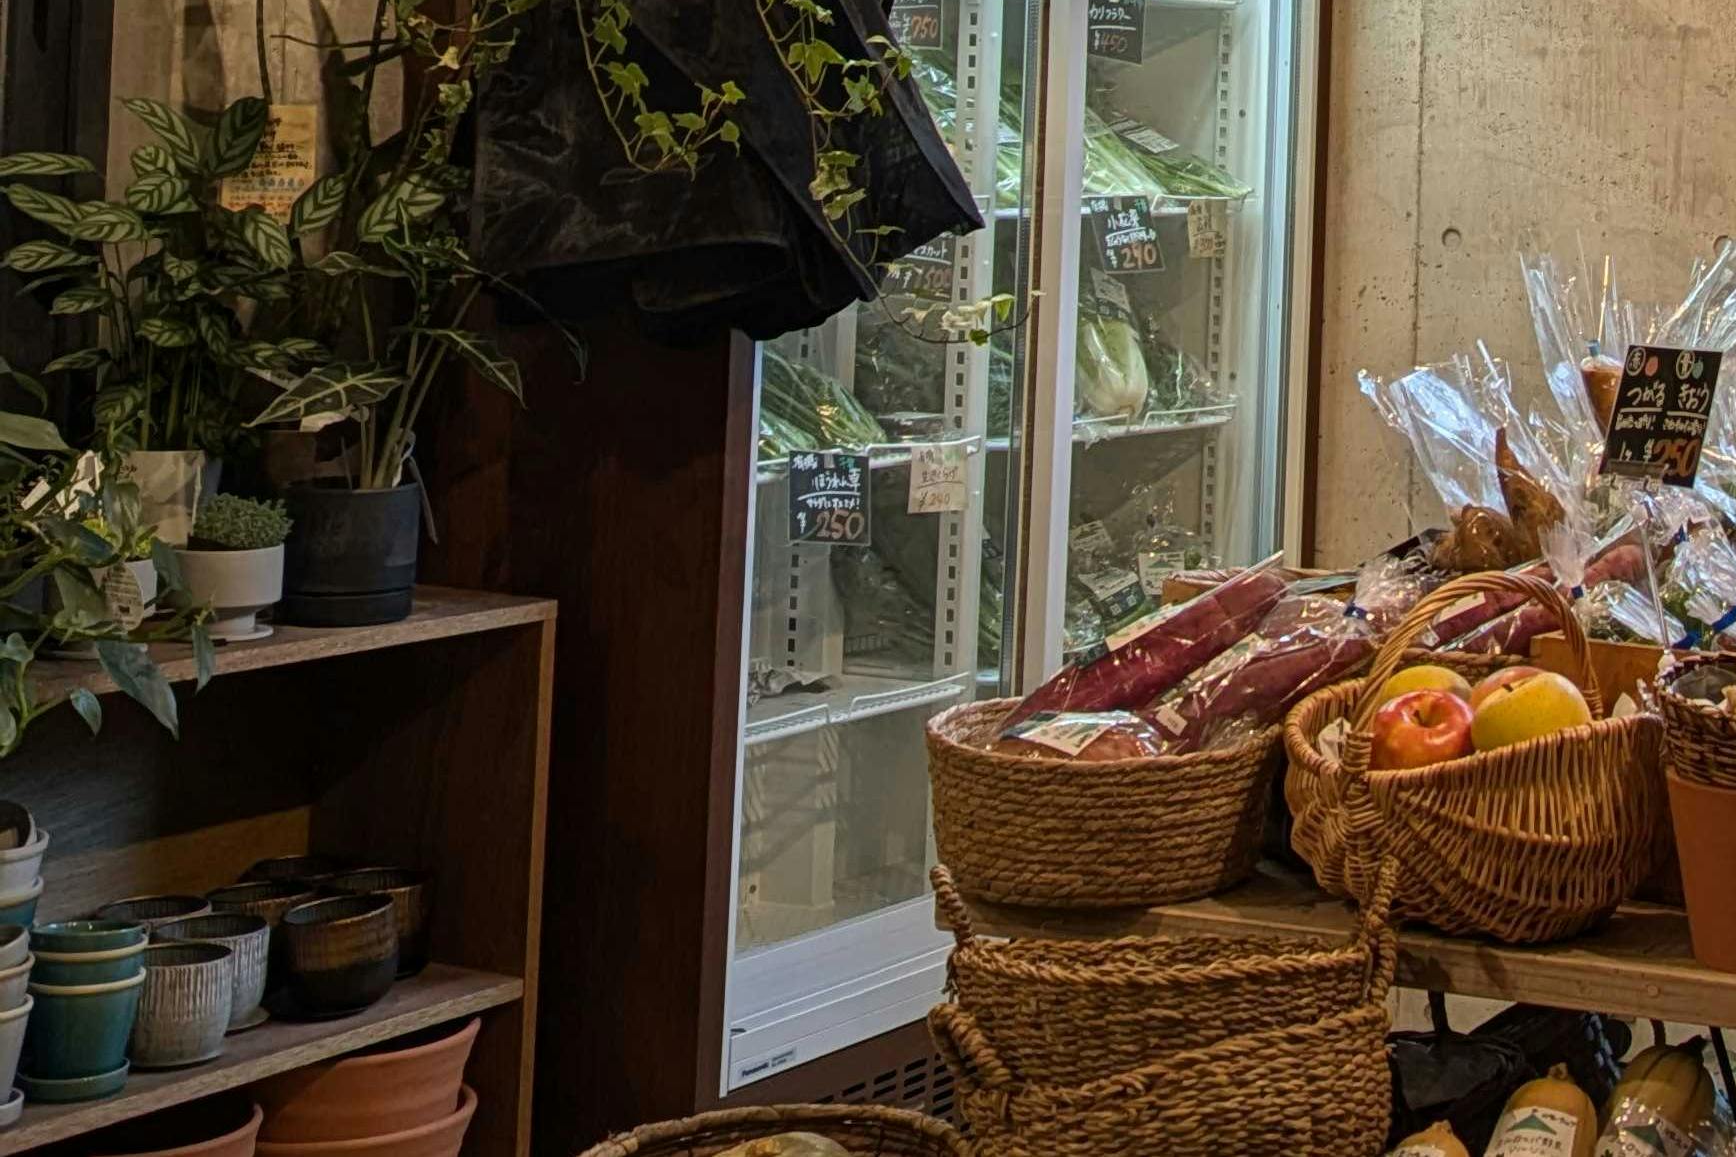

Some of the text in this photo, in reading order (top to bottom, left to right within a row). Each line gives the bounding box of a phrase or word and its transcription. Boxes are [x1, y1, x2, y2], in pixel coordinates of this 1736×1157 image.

[1088, 3, 1134, 21] カリフラワー
[1627, 381, 1666, 408] つがる
[811, 468, 862, 493] ほうれん草
[796, 511, 865, 541] ¥250
